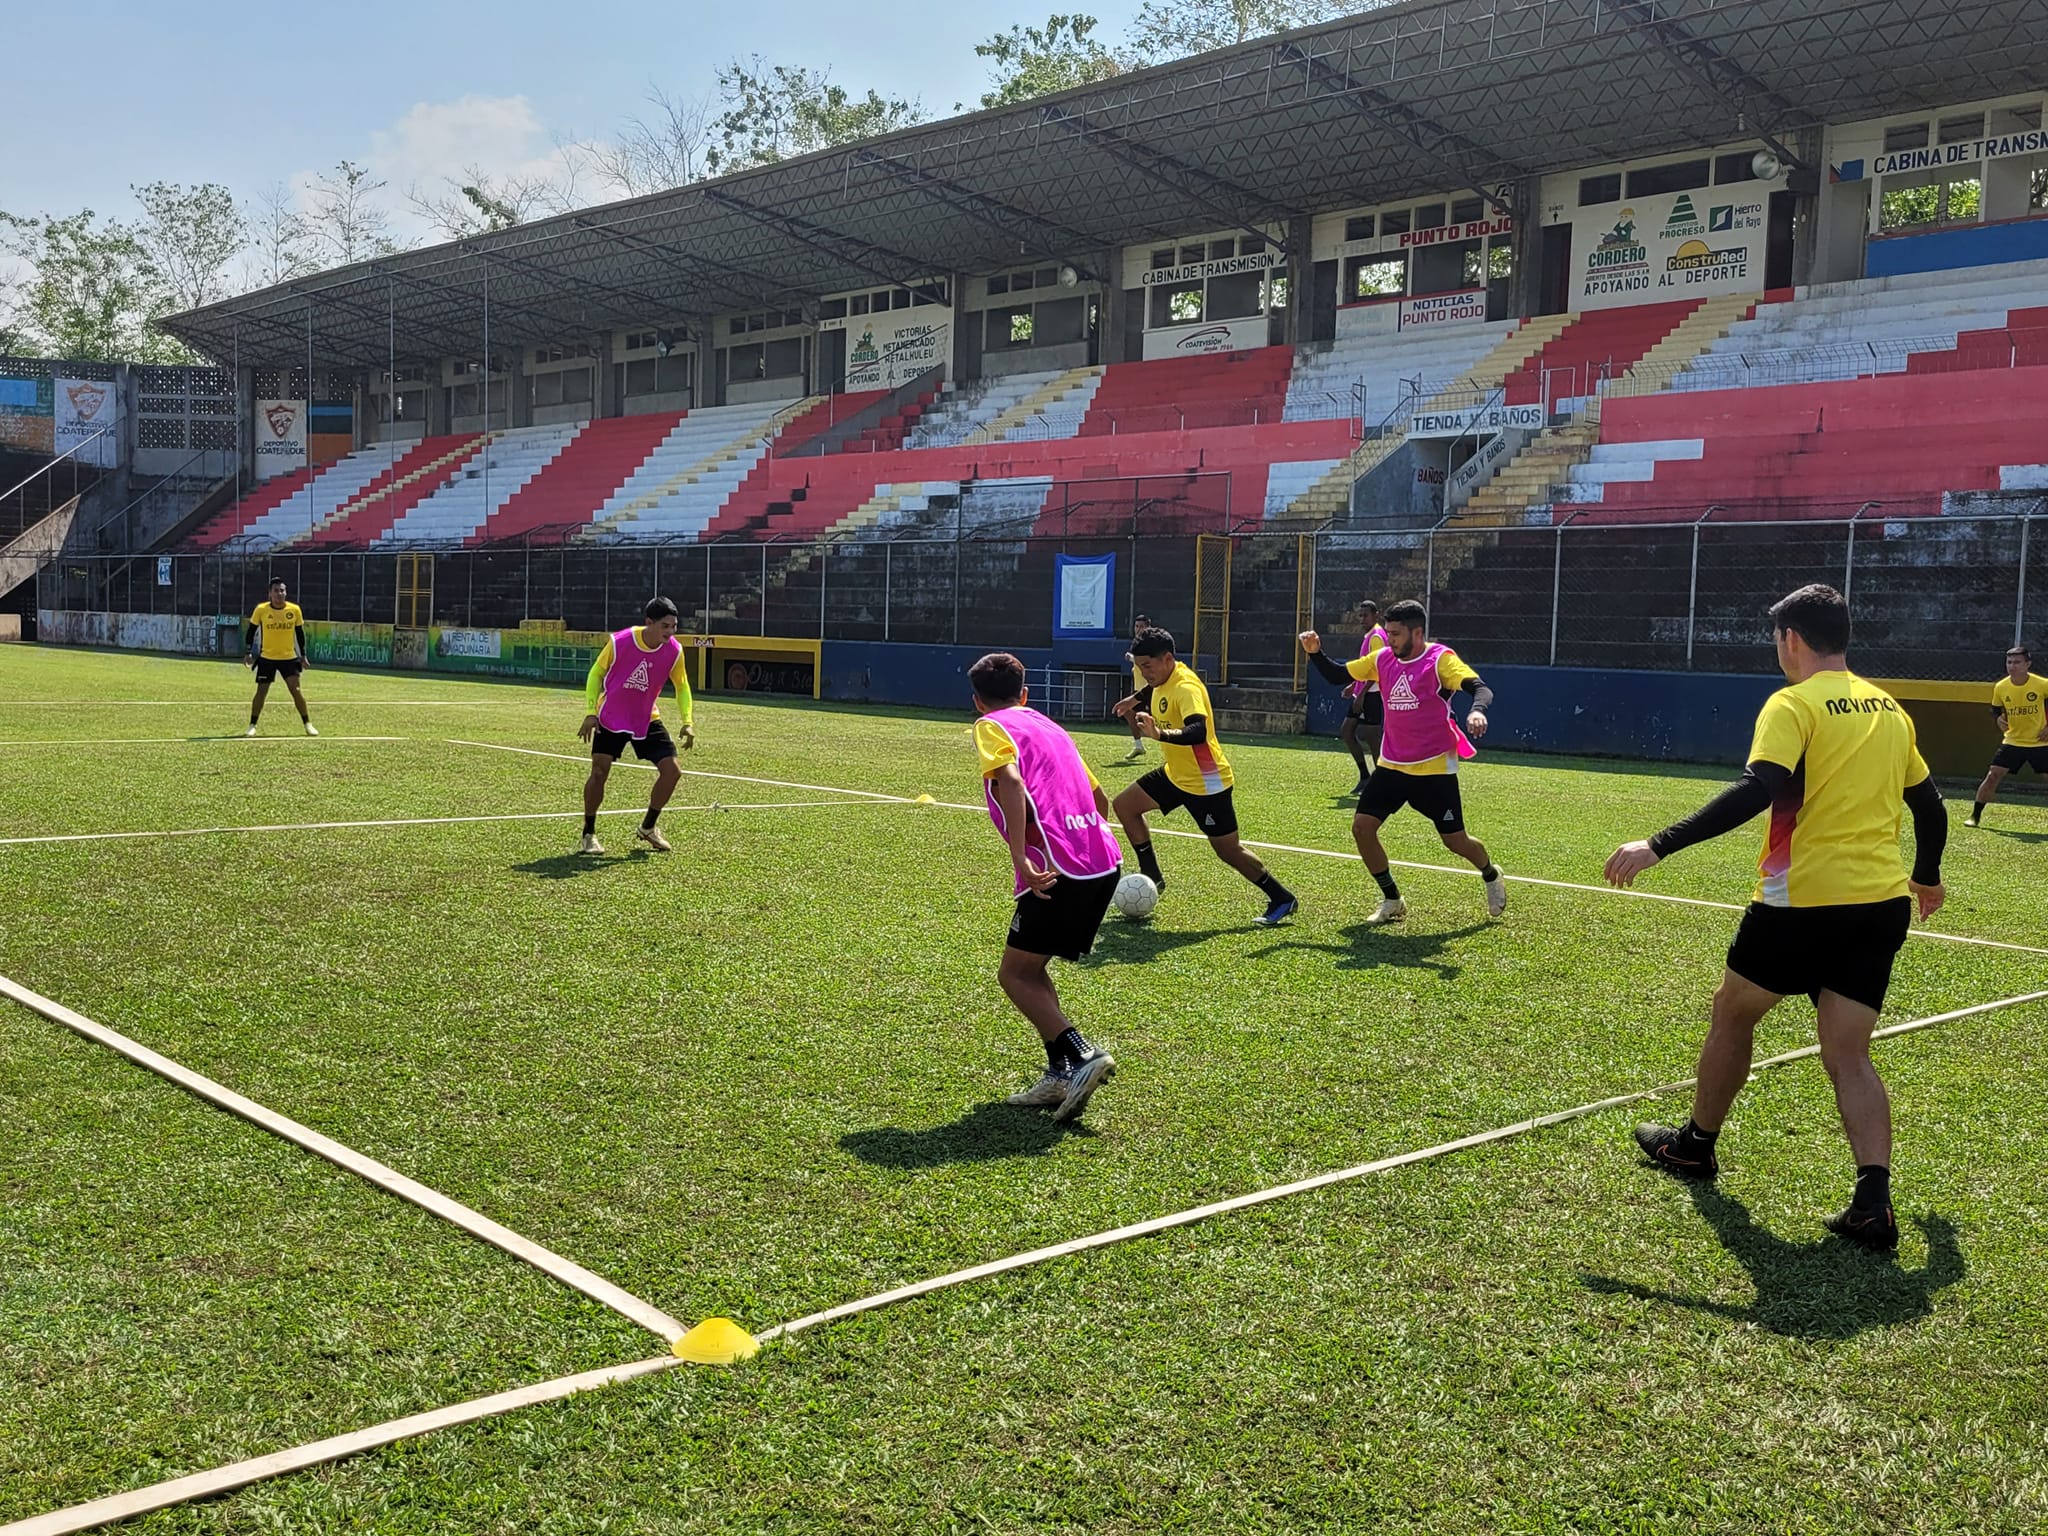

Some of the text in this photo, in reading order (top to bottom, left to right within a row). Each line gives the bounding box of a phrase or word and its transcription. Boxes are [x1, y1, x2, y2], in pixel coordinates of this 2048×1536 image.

[1874, 148, 1942, 173] CABINA
[1946, 143, 1969, 162] DE
[1734, 203, 1762, 215] Hierro
[1733, 216, 1761, 229] del Rayo
[1400, 226, 1461, 247] PUNTO
[1465, 217, 1512, 237] ROJO
[1588, 246, 1647, 268] CORDERO
[1668, 248, 1746, 270] ConstruRed
[1142, 254, 1275, 285] CABINA DE TRANSMISION
[1624, 270, 1635, 278] LAS
[1584, 264, 1747, 297] APOYANDO AL DEPORTE
[1413, 294, 1474, 311] NOTICIAS
[1402, 309, 1446, 326] PUNTO
[1450, 305, 1485, 319] ROJO
[894, 325, 932, 339] VICTORIAS
[850, 350, 879, 363] CORDERO
[885, 348, 934, 364] RETALHULEU
[849, 372, 880, 385] APOYANDO
[1413, 407, 1541, 431] TIENDA Y BAÑOS
[1456, 438, 1506, 489] TIENDA Y BAÑOS
[1417, 466, 1445, 485] BAÑOS
[452, 631, 489, 643] RENTA DE
[693, 638, 714, 647] LOCAL
[314, 642, 332, 657] PARA
[1825, 697, 1898, 716] nevima
